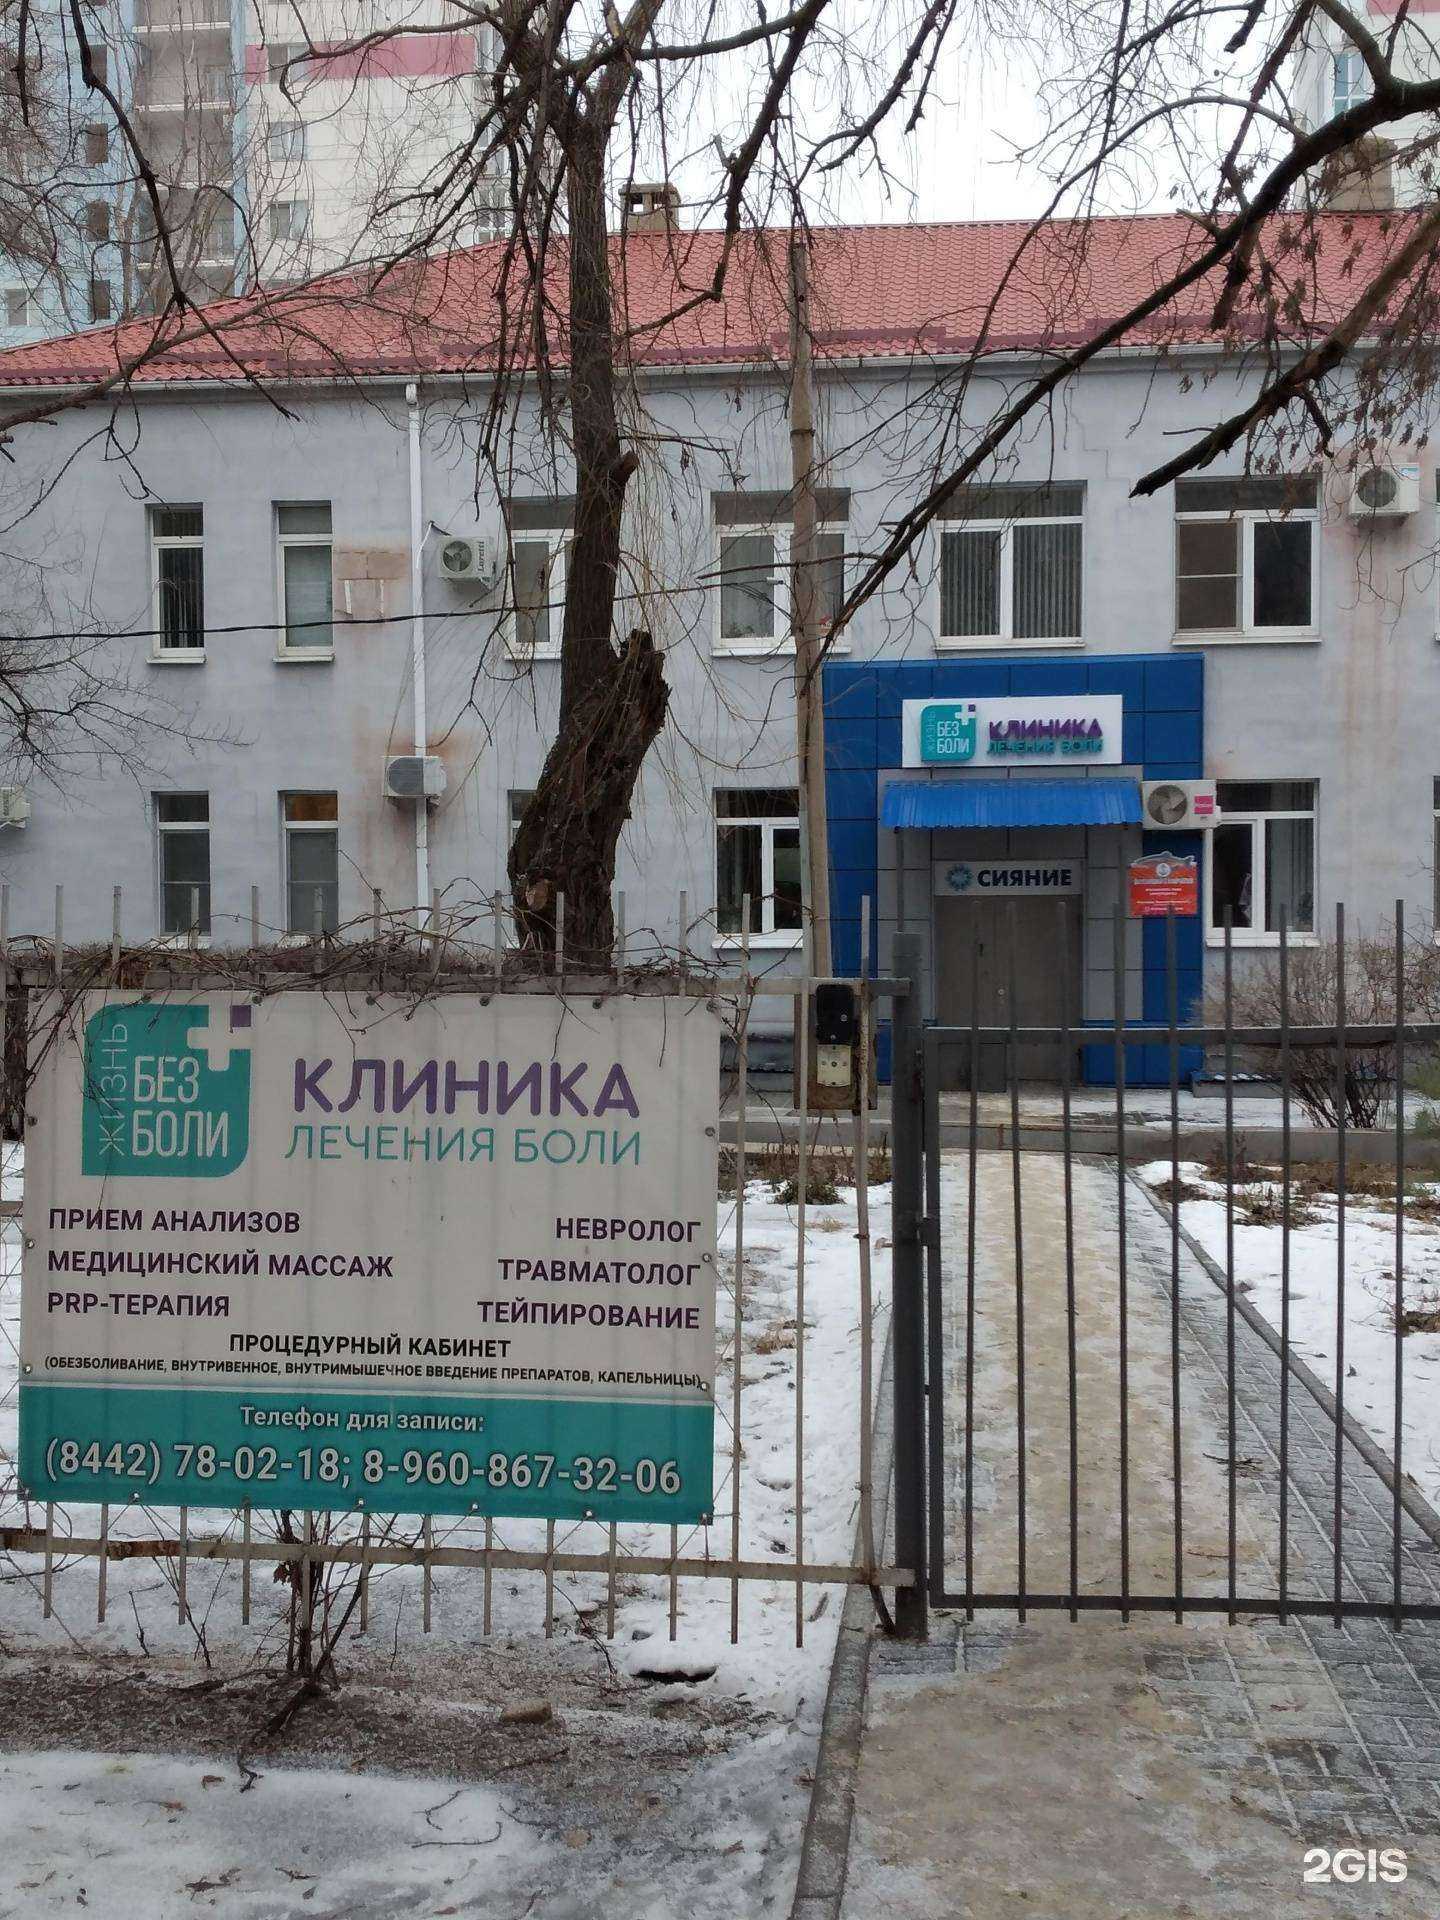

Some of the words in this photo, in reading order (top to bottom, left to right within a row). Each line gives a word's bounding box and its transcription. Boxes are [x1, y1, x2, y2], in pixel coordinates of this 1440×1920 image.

[937, 721, 960, 737] БЕЗ
[989, 718, 1103, 740] КЛИНИКА
[937, 738, 969, 754] БОЛИ
[977, 869, 1072, 887] СИЯНИЕ
[99, 1023, 128, 1156] ЖИЗНЬ
[134, 1056, 200, 1103] БЕЗ
[294, 1058, 640, 1118] КЛИНИКА
[131, 1109, 229, 1158] БОЛИ
[285, 1125, 495, 1162] ЛЕЧЕНИЯ
[514, 1128, 640, 1165] БОЛИ
[49, 1208, 143, 1231] ПРИЕМ
[151, 1210, 301, 1234] АНАЛИЗОВ
[555, 1217, 701, 1243] НЕВРОЛОГ
[48, 1249, 260, 1277] МЕДИЦИНСКИЙ
[268, 1253, 394, 1278] МАССАЖ
[498, 1258, 701, 1286] ТРАВМАТОЛОГ
[47, 1292, 230, 1317] PRP-ТЕРАПИЯ
[477, 1297, 700, 1330] ТЕЙПИРОВАНИЕ
[229, 1332, 401, 1357] ПРОЦЕДУРНЫЙ
[408, 1338, 511, 1358] КАБИНЕТ
[45, 1356, 168, 1373] (ОБЕЗБОЛИВАНИЕ,
[171, 1360, 282, 1376] ВНУТРИВЕННОЕ,
[285, 1362, 422, 1378] ВНУТРИМЫШЕЧНОЕ
[425, 1366, 498, 1380] ВВЕДЕНИЕ
[501, 1367, 594, 1384] ПРЕПАРАТОВ,
[240, 1406, 340, 1430] Телефон
[346, 1411, 389, 1432] для
[396, 1413, 485, 1432] записи:
[46, 1438, 161, 1485] (8442)
[173, 1444, 351, 1488] 78-02-18;
[363, 1449, 681, 1495] 8-960-867-32-06
